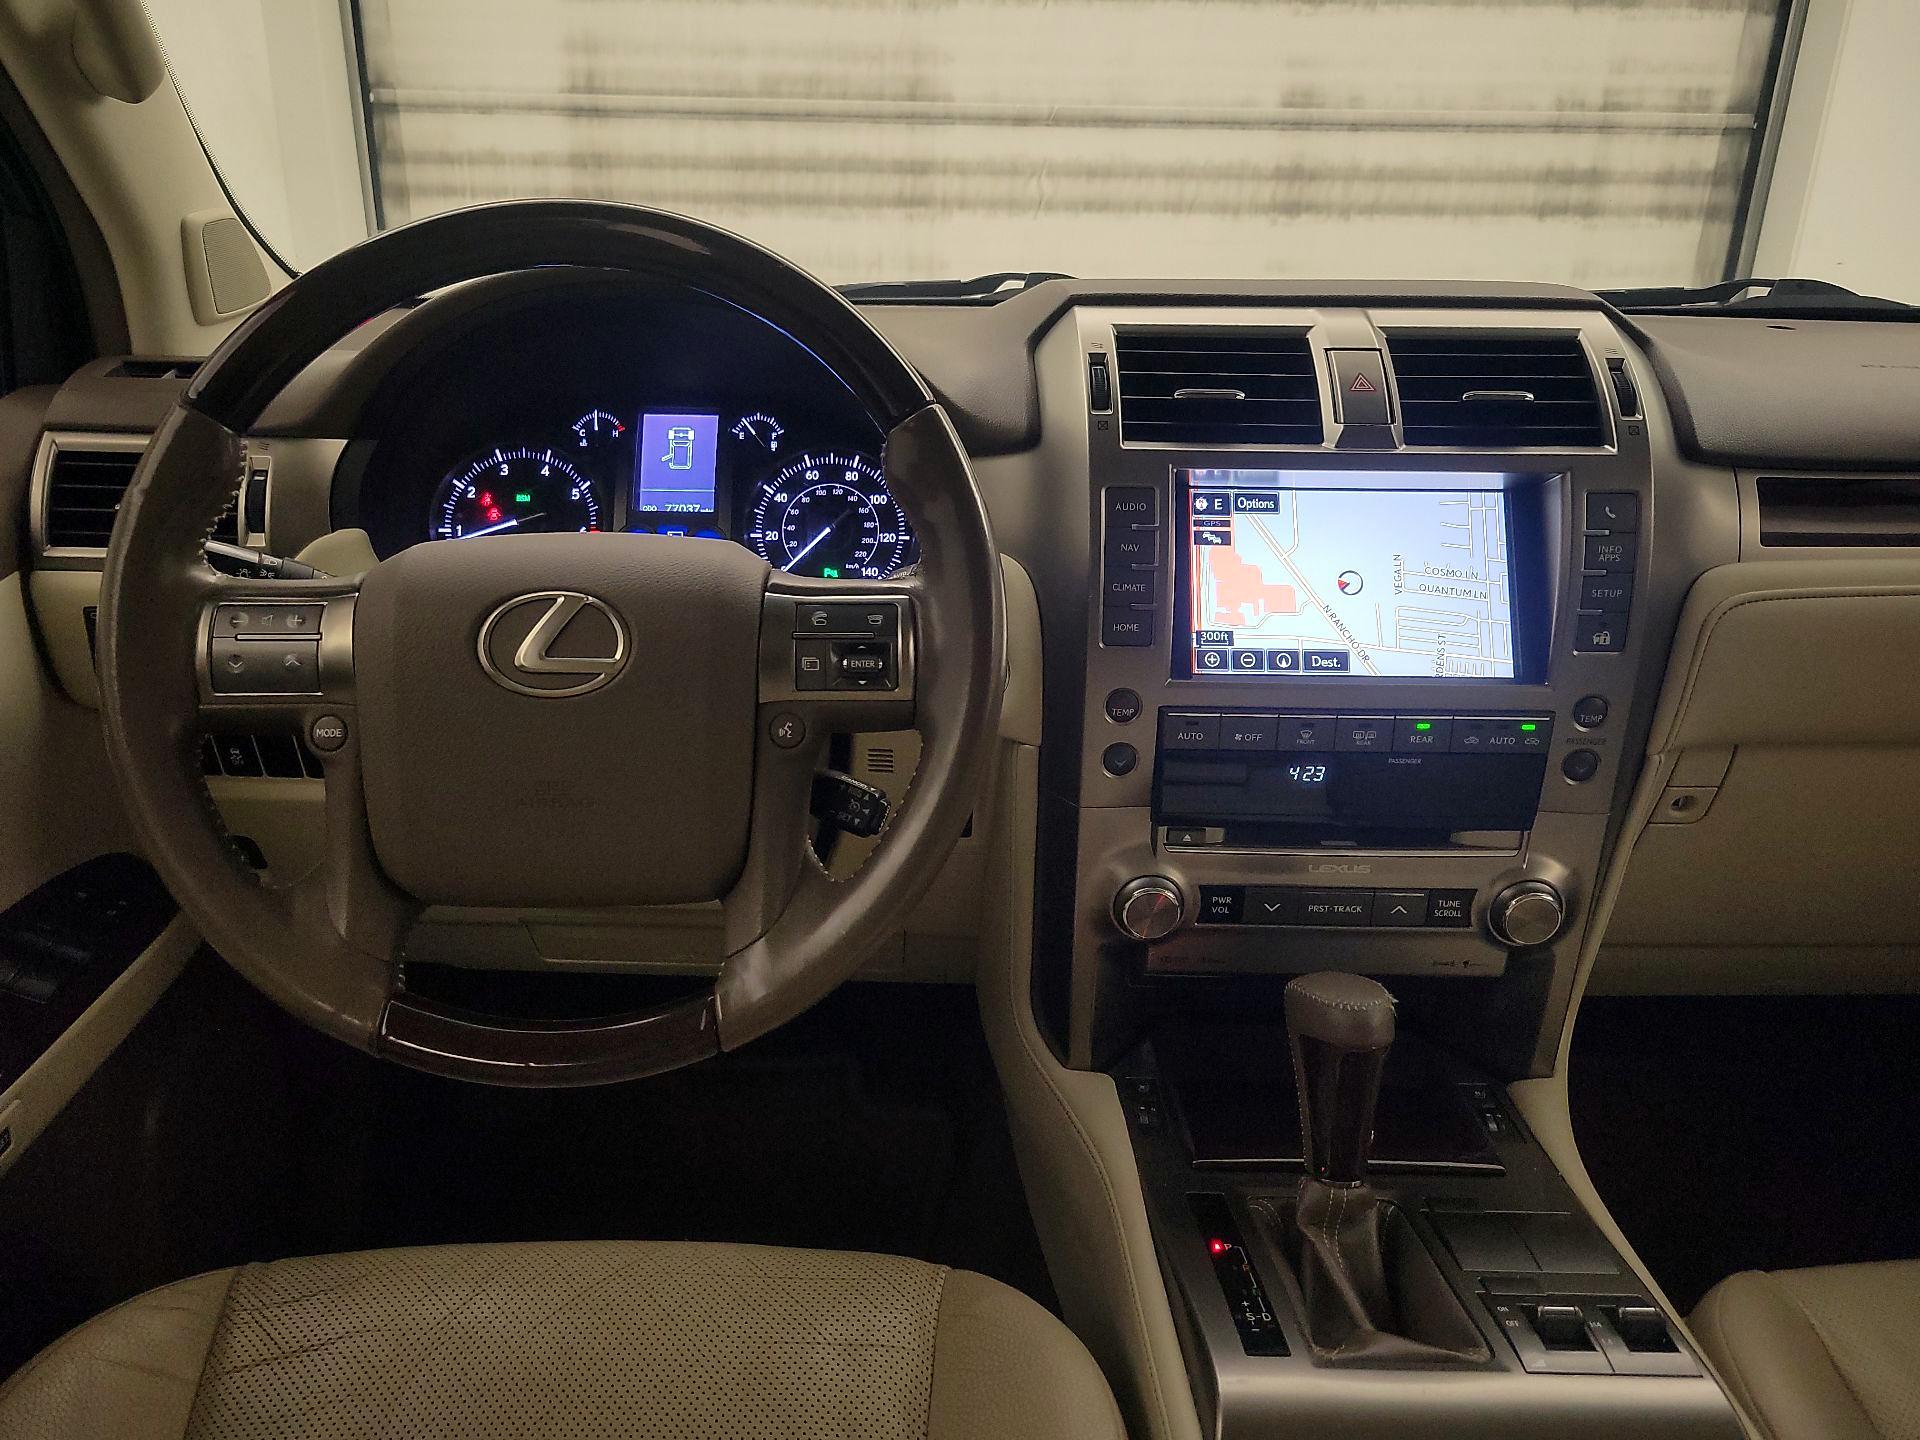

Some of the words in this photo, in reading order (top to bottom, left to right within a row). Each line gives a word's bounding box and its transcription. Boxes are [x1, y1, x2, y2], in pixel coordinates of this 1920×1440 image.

[499, 463, 509, 476] 3
[541, 464, 550, 477] 4
[805, 470, 820, 481] 60
[845, 471, 859, 482] 80
[466, 486, 476, 499] 2
[571, 488, 580, 500] 5
[515, 494, 531, 502] BSM
[773, 493, 788, 503] 40
[869, 494, 887, 505] 100
[664, 503, 701, 513] 77037
[1115, 503, 1147, 511] AUDIO
[1214, 498, 1223, 511] E
[1237, 497, 1275, 510] Options
[765, 531, 779, 541] 20
[879, 533, 896, 543] 120
[1120, 544, 1140, 552] NAV
[1598, 545, 1623, 553] INFO
[1598, 553, 1622, 562] APPS
[861, 567, 879, 577] 140
[1424, 566, 1463, 578] COSMO
[1465, 571, 1479, 580] LN
[1394, 566, 1403, 595] VEGA
[1112, 583, 1146, 592] CLIMATE
[1419, 583, 1472, 598] QUANTUM
[1473, 590, 1487, 599] LN
[1591, 588, 1623, 597] SETUP
[1113, 624, 1140, 632] HOME
[1200, 631, 1229, 641] 300ft
[1323, 605, 1332, 613] N
[1329, 612, 1360, 651] RANCHO
[1357, 650, 1370, 664] DR
[1437, 633, 1447, 645] ST
[850, 659, 875, 668] ENTER
[1311, 656, 1341, 667] Dest.
[1111, 708, 1135, 717] TEMP
[1580, 714, 1603, 723] TEMP
[316, 728, 343, 738] MODE
[1177, 732, 1204, 741] AUTO
[1244, 733, 1262, 742] OFF
[1410, 735, 1434, 744] REAR
[1489, 736, 1516, 745] AUTO
[1388, 757, 1422, 765] PASSENGER
[1308, 863, 1371, 874] LEXUS
[1212, 896, 1233, 904] PWR
[1438, 899, 1461, 908] TUNE
[1211, 906, 1230, 915] VOL
[1434, 909, 1462, 918] SCROLL
